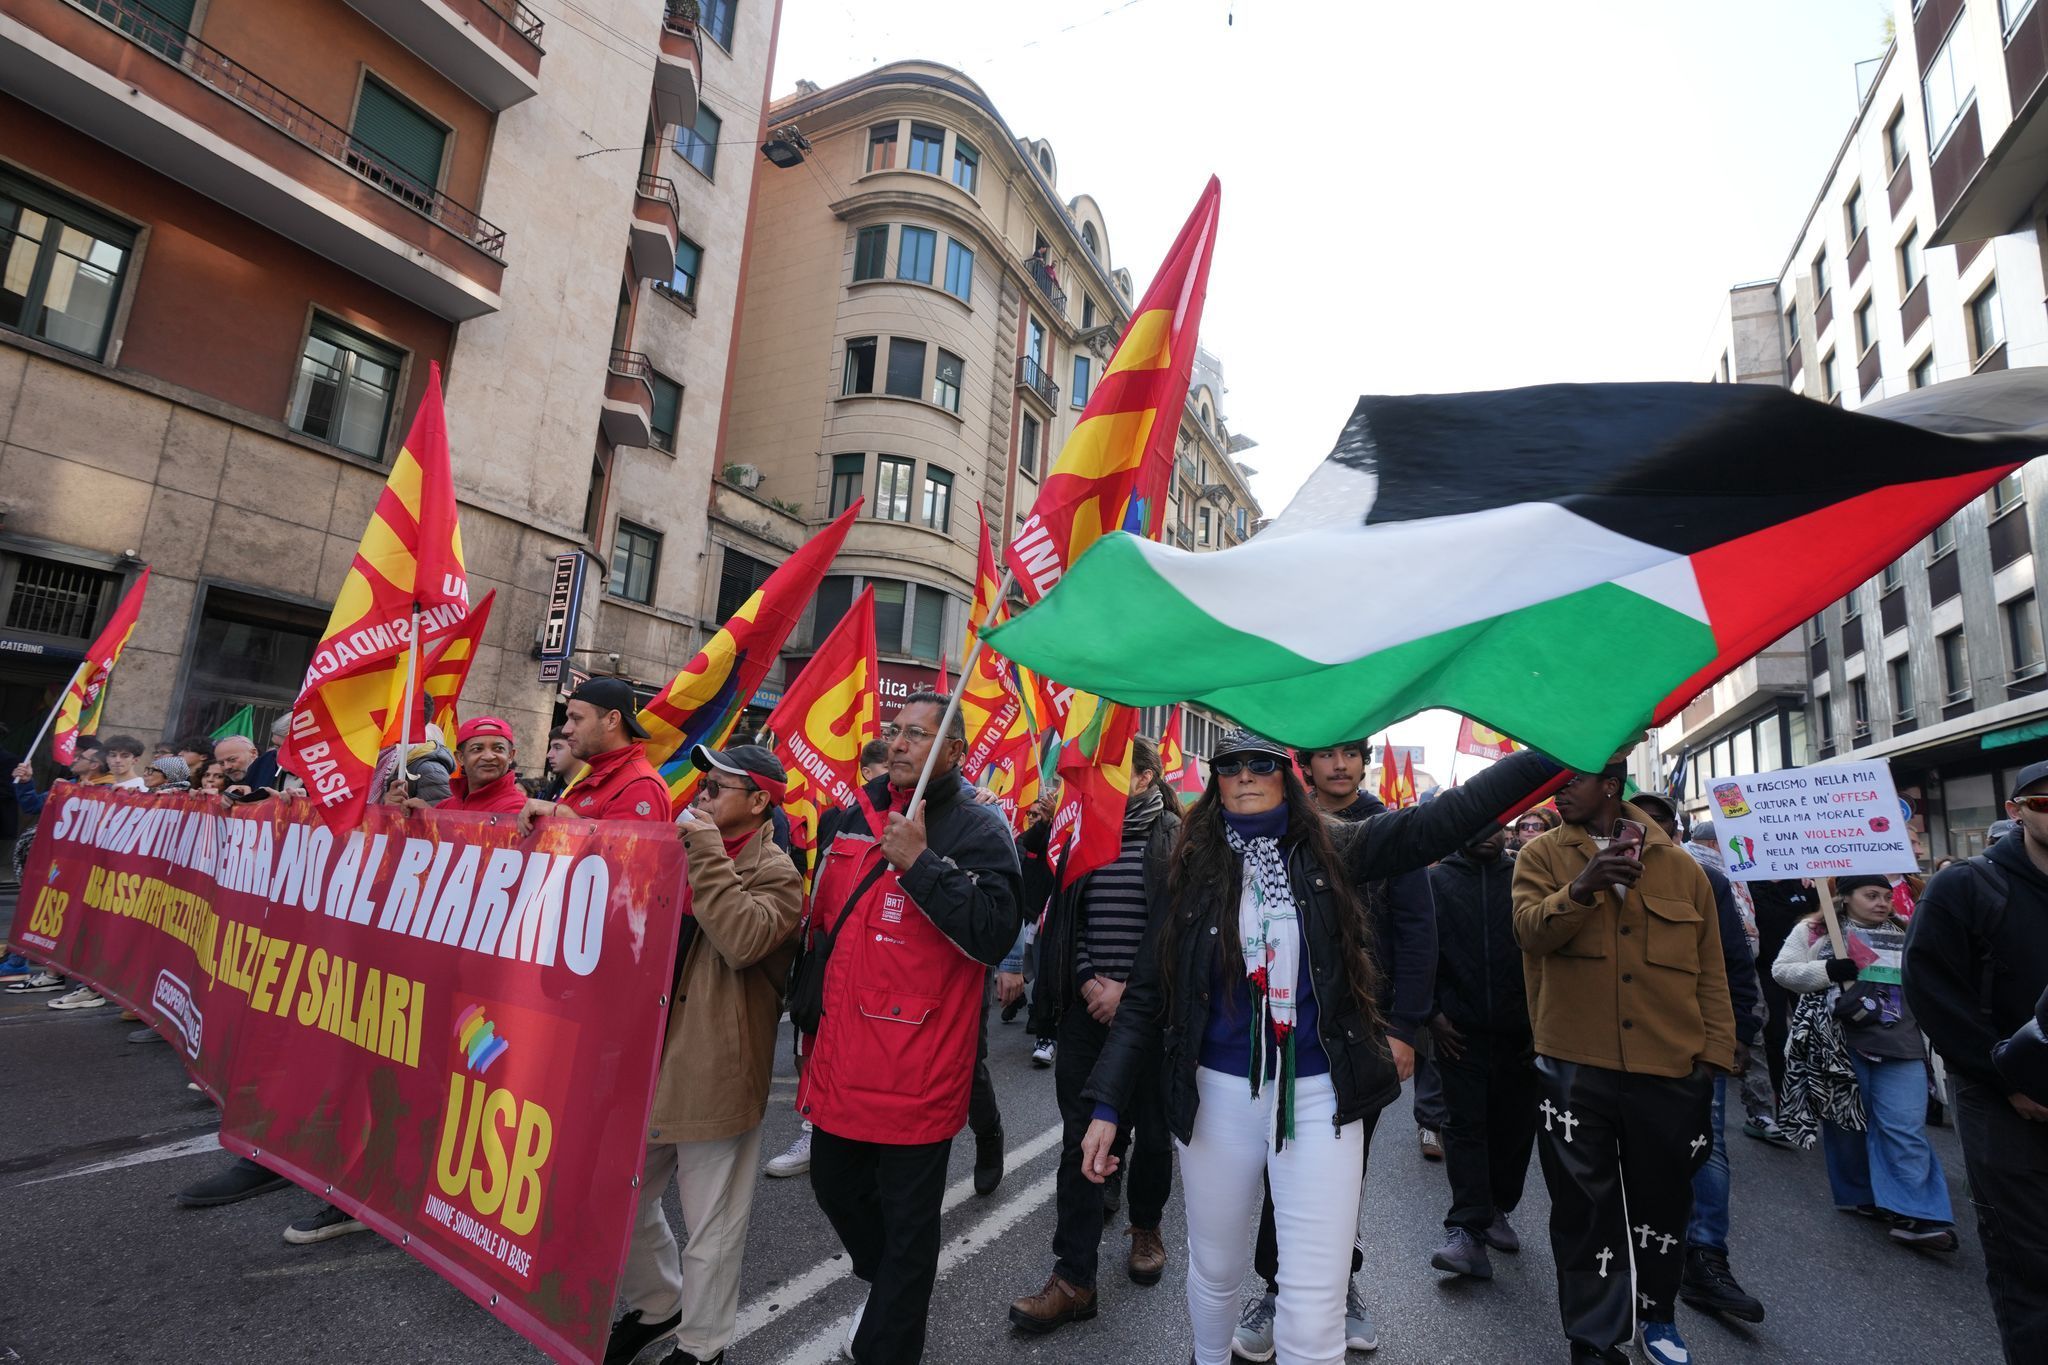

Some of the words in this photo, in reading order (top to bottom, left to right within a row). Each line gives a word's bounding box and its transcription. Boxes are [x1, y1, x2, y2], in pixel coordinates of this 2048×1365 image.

[0, 641, 44, 654] CATERING
[787, 730, 836, 788] UNIONE
[298, 740, 354, 809] BASE
[1746, 781, 1755, 793] IL
[1757, 779, 1808, 792] FASCISMO
[1815, 772, 1849, 787] NELLA
[1852, 771, 1877, 783] MIA
[1754, 798, 1797, 810] CULTURA
[1758, 813, 1791, 824] NELLA
[1793, 811, 1811, 822] MIA
[1817, 809, 1865, 820] MORALE
[1776, 831, 1799, 841] UNA
[1804, 828, 1865, 839] VIOLENZA
[1766, 845, 1795, 857] NELLA
[1801, 845, 1819, 855] MIA
[1824, 841, 1904, 855] COSTITUZIONE
[1784, 862, 1799, 871] UN
[1806, 859, 1853, 870] CRIMINE
[270, 822, 334, 912] NO
[323, 831, 389, 926] AL
[377, 838, 610, 976] RIARMO
[886, 897, 902, 909] BRT
[29, 885, 69, 938] USB
[275, 943, 308, 1018] I
[297, 947, 426, 1069] SALARI
[436, 1071, 553, 1236] USB
[425, 1194, 456, 1228] UNIONE
[452, 1211, 499, 1256] SINDACALE
[496, 1237, 510, 1262] DI
[507, 1243, 533, 1278] BASE
